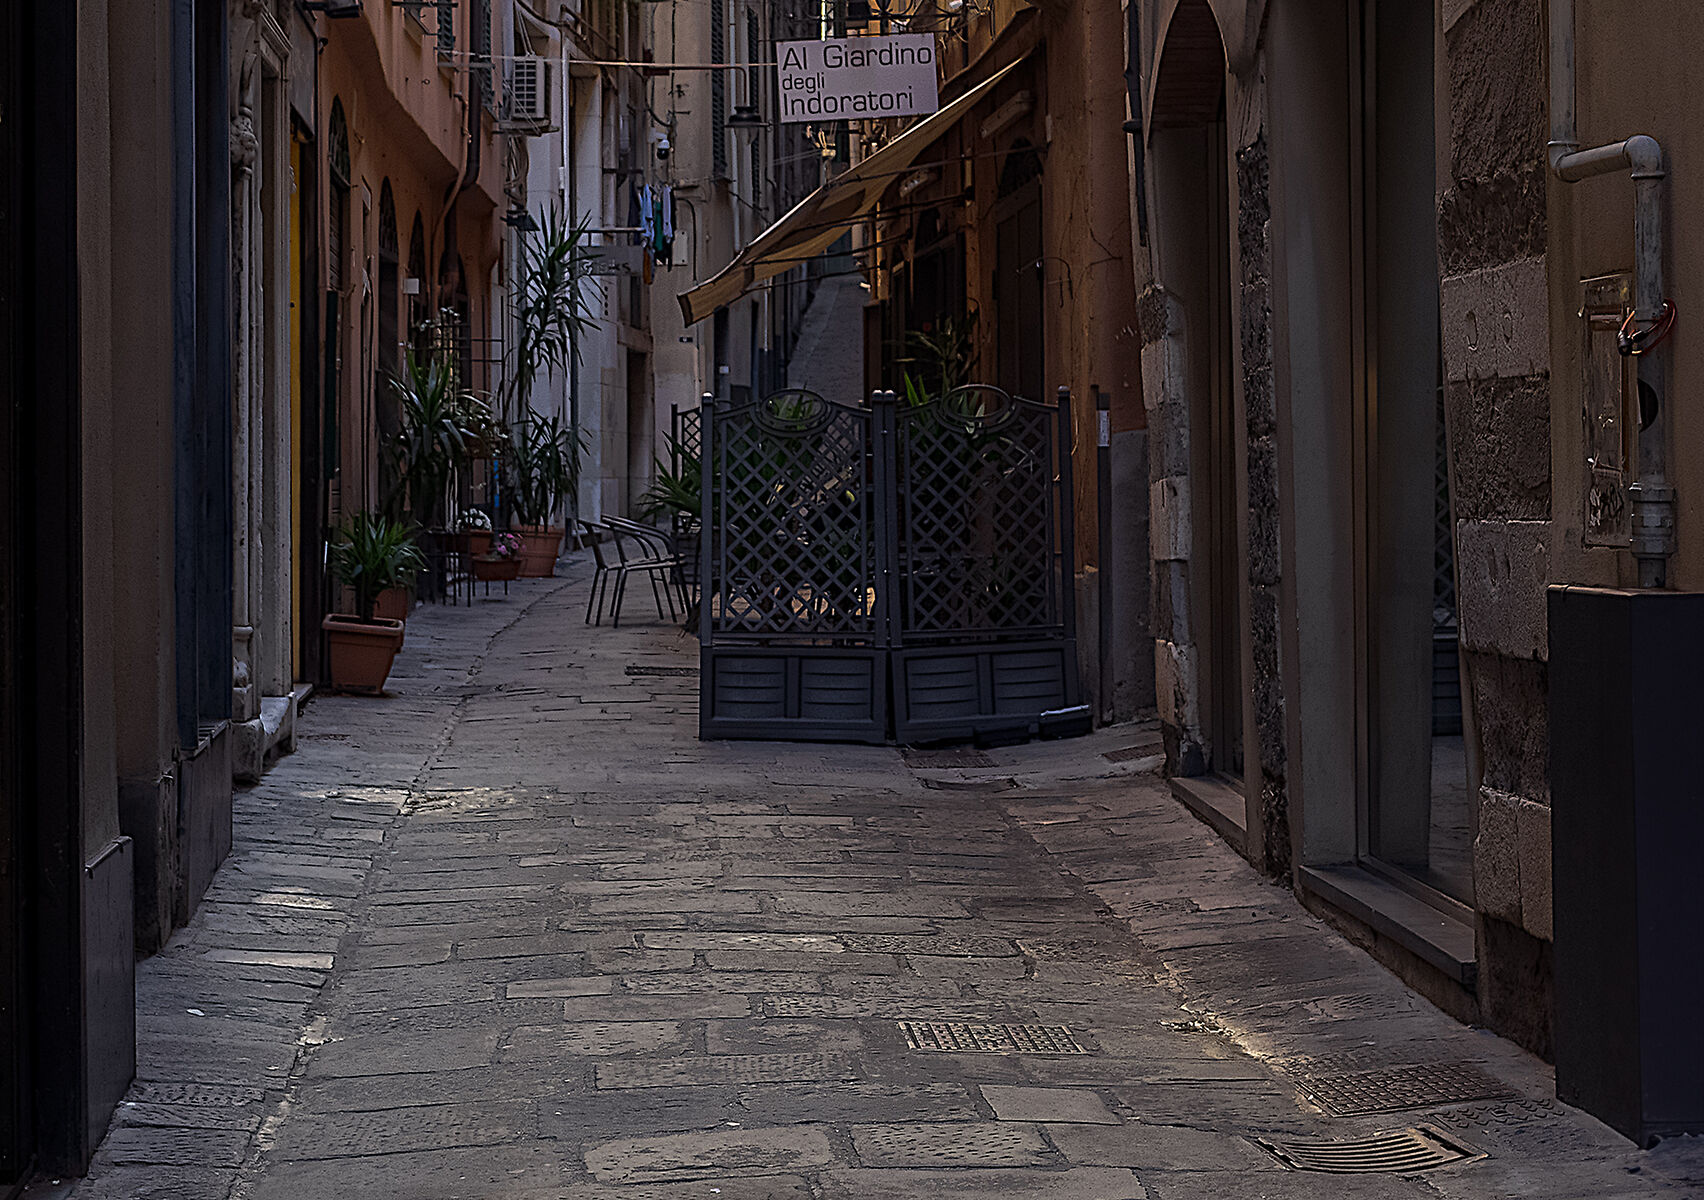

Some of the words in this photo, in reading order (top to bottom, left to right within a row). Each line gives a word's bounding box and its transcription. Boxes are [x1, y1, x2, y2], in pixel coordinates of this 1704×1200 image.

[783, 46, 807, 71] Al
[823, 42, 932, 69] Giardino
[782, 72, 825, 93] degli
[783, 85, 913, 116] Indoratori
